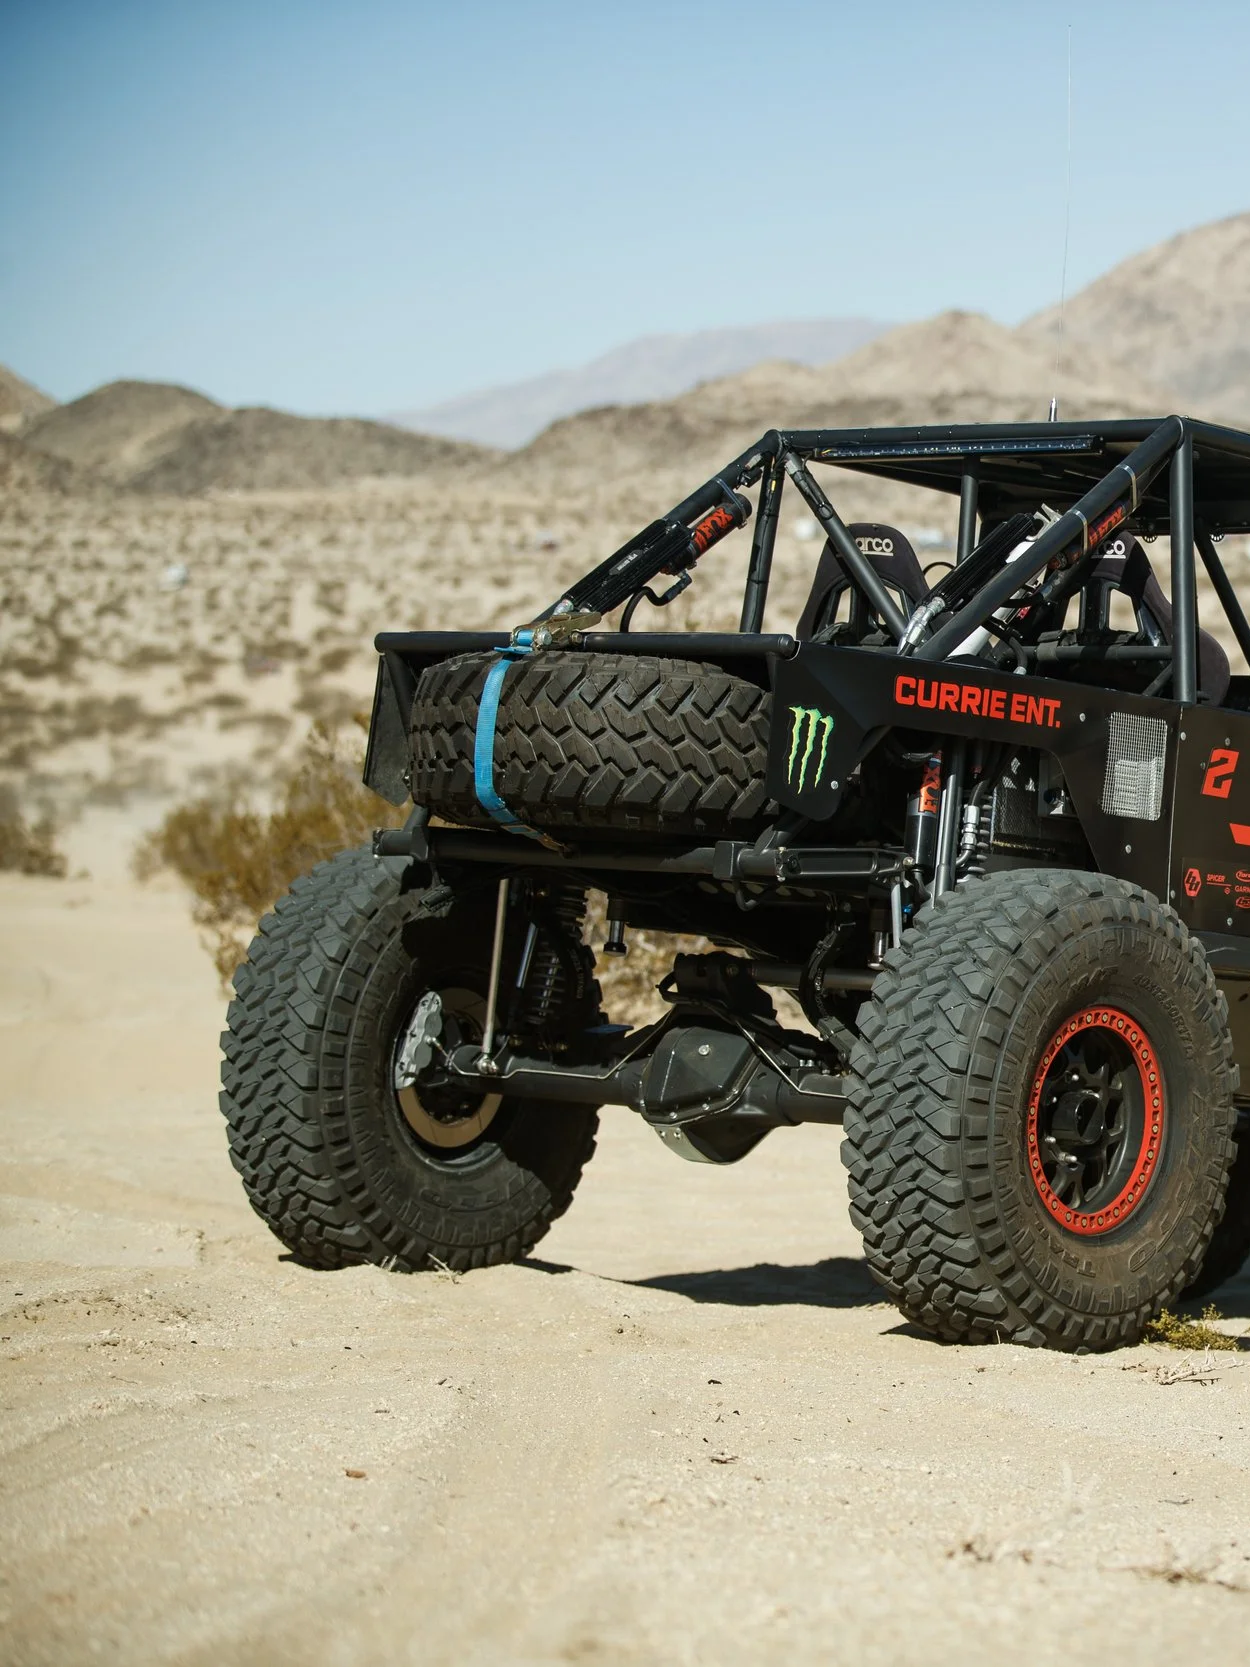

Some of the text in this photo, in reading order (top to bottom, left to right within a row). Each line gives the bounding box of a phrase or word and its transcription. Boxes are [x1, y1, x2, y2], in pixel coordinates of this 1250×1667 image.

[856, 537, 893, 553] arco
[895, 675, 1061, 728] CURRIE ENT.
[1202, 748, 1239, 799] 2
[1206, 873, 1226, 883] SPICER
